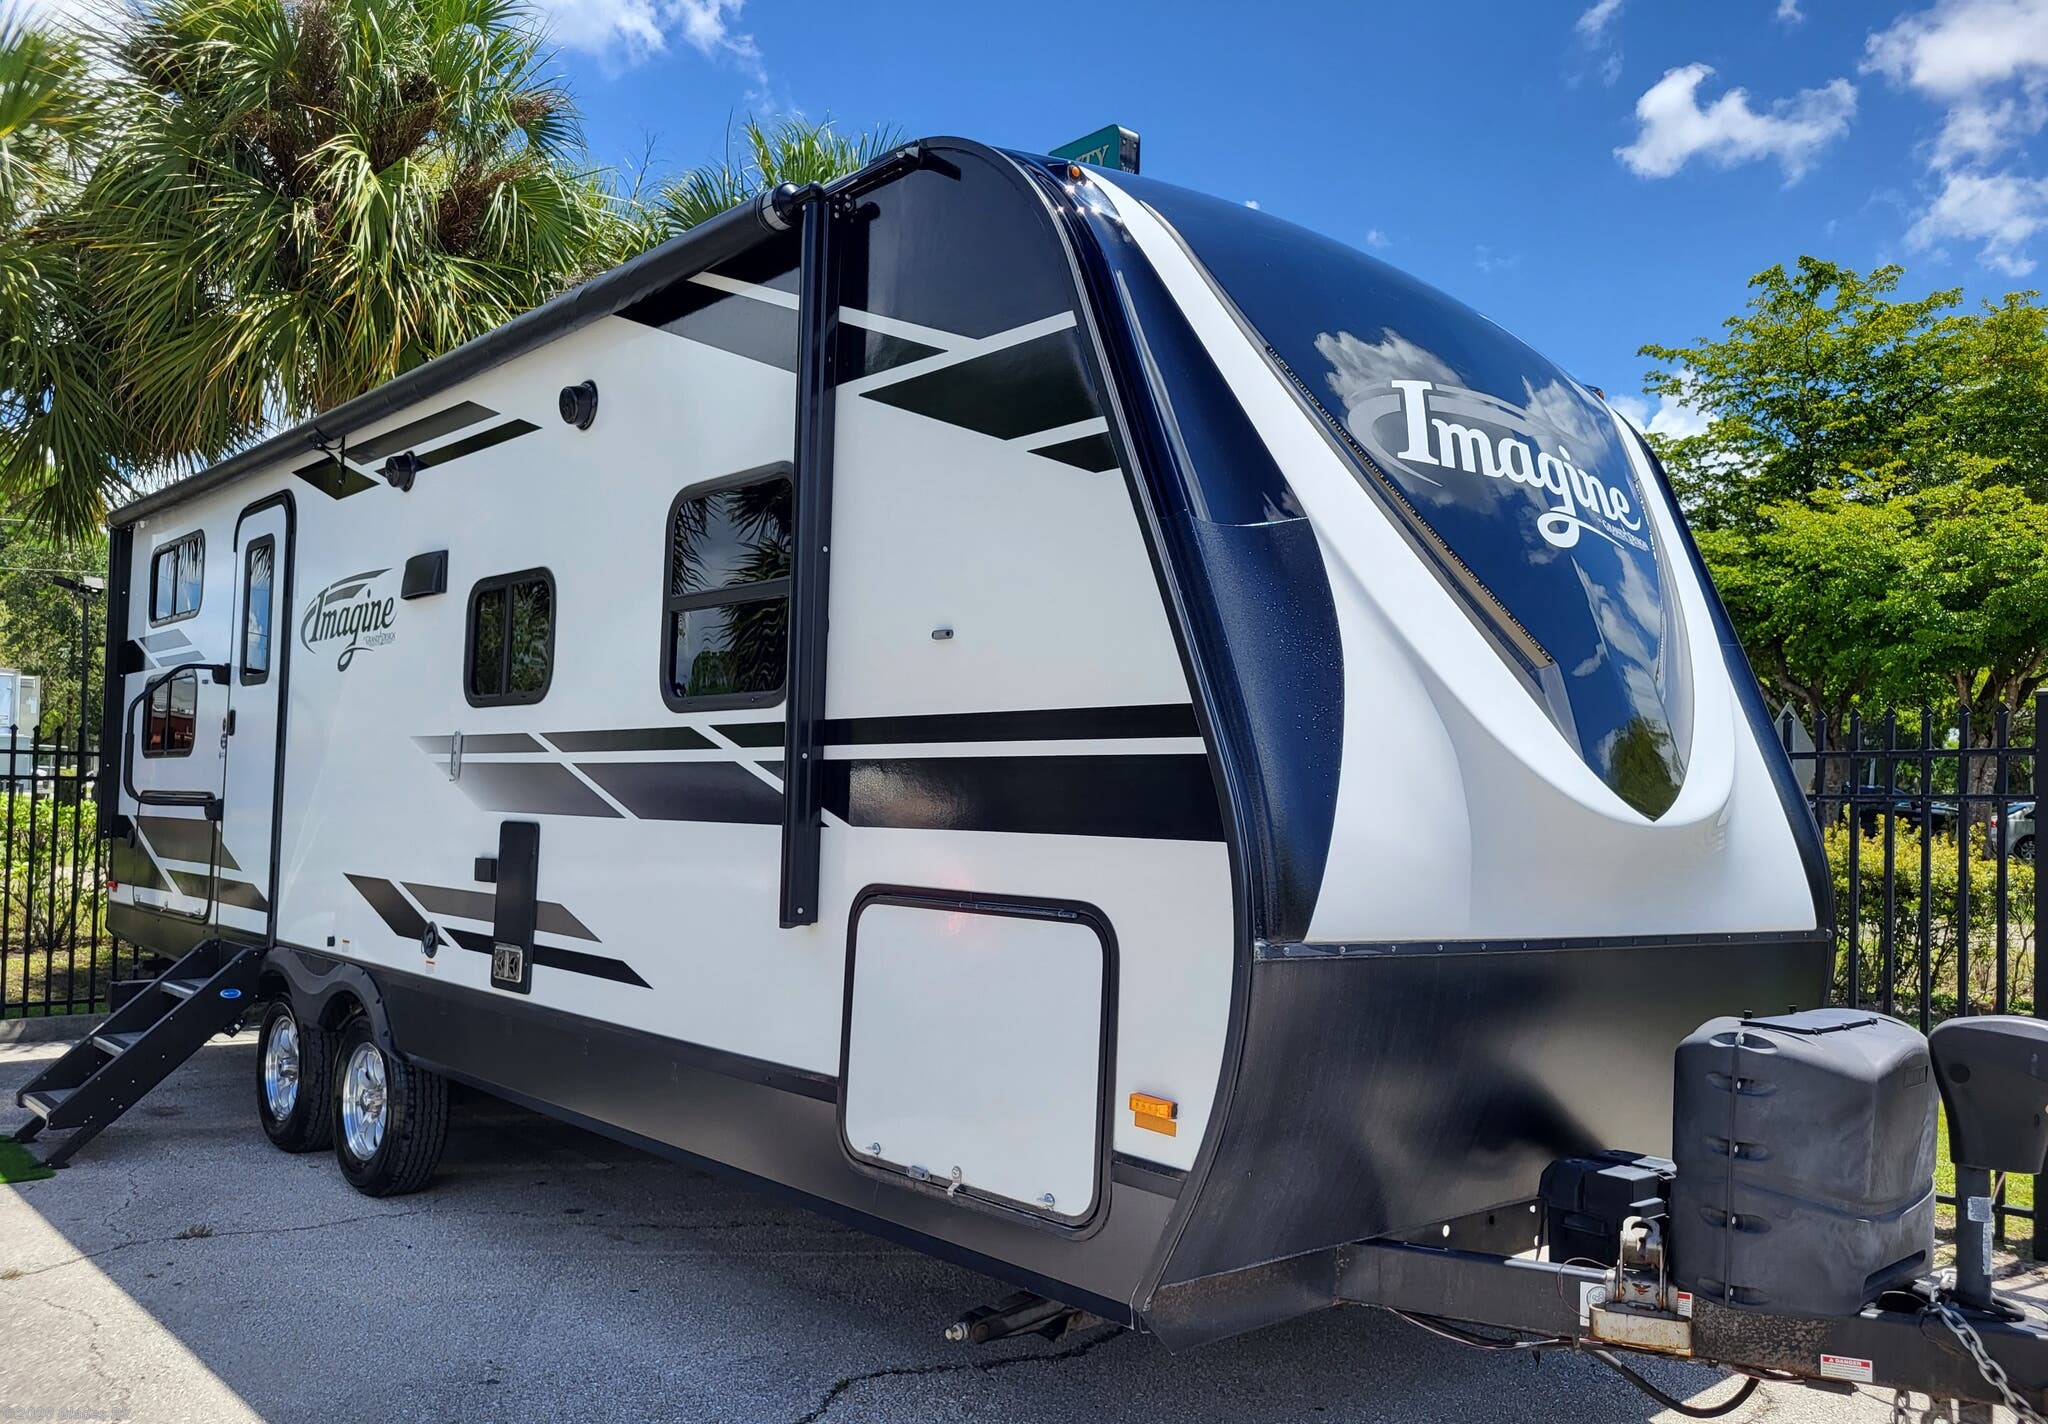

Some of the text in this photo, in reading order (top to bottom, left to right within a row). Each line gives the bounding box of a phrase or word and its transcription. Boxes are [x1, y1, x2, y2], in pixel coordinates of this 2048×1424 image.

[1391, 379, 1641, 548] Imagine
[308, 587, 397, 673] Imagine
[1835, 1358, 1862, 1367] DANGER
